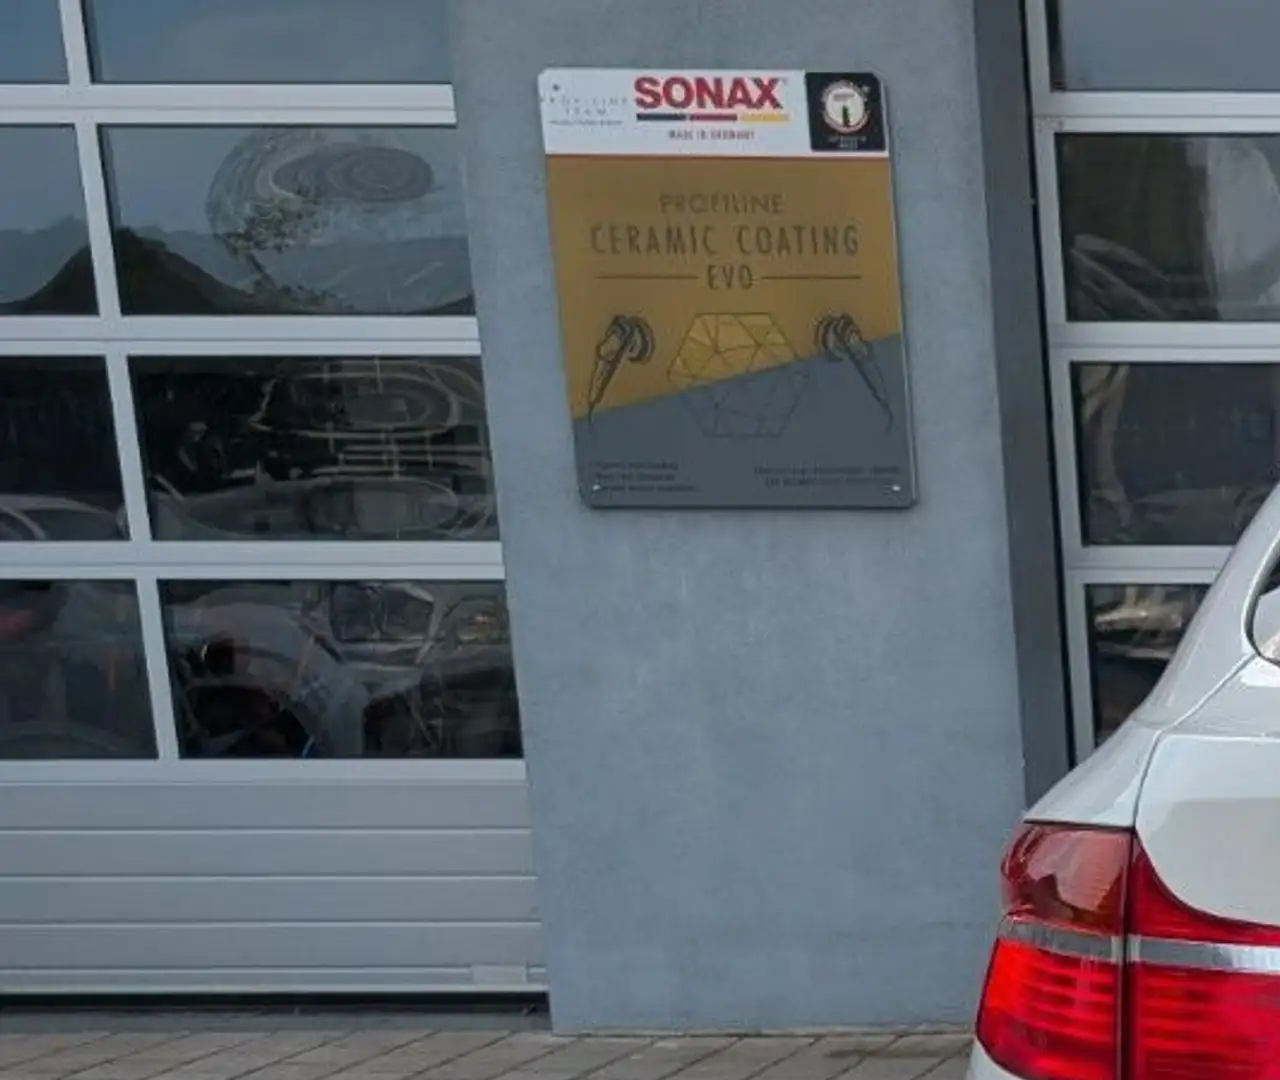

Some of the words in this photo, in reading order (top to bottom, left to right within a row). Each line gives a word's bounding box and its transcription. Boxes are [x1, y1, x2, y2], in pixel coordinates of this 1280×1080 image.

[633, 76, 783, 110] SONAX
[659, 193, 785, 215] PROFILINE
[590, 225, 718, 256] CERAMIC
[736, 224, 860, 256] COATING
[706, 263, 754, 291] EVO
